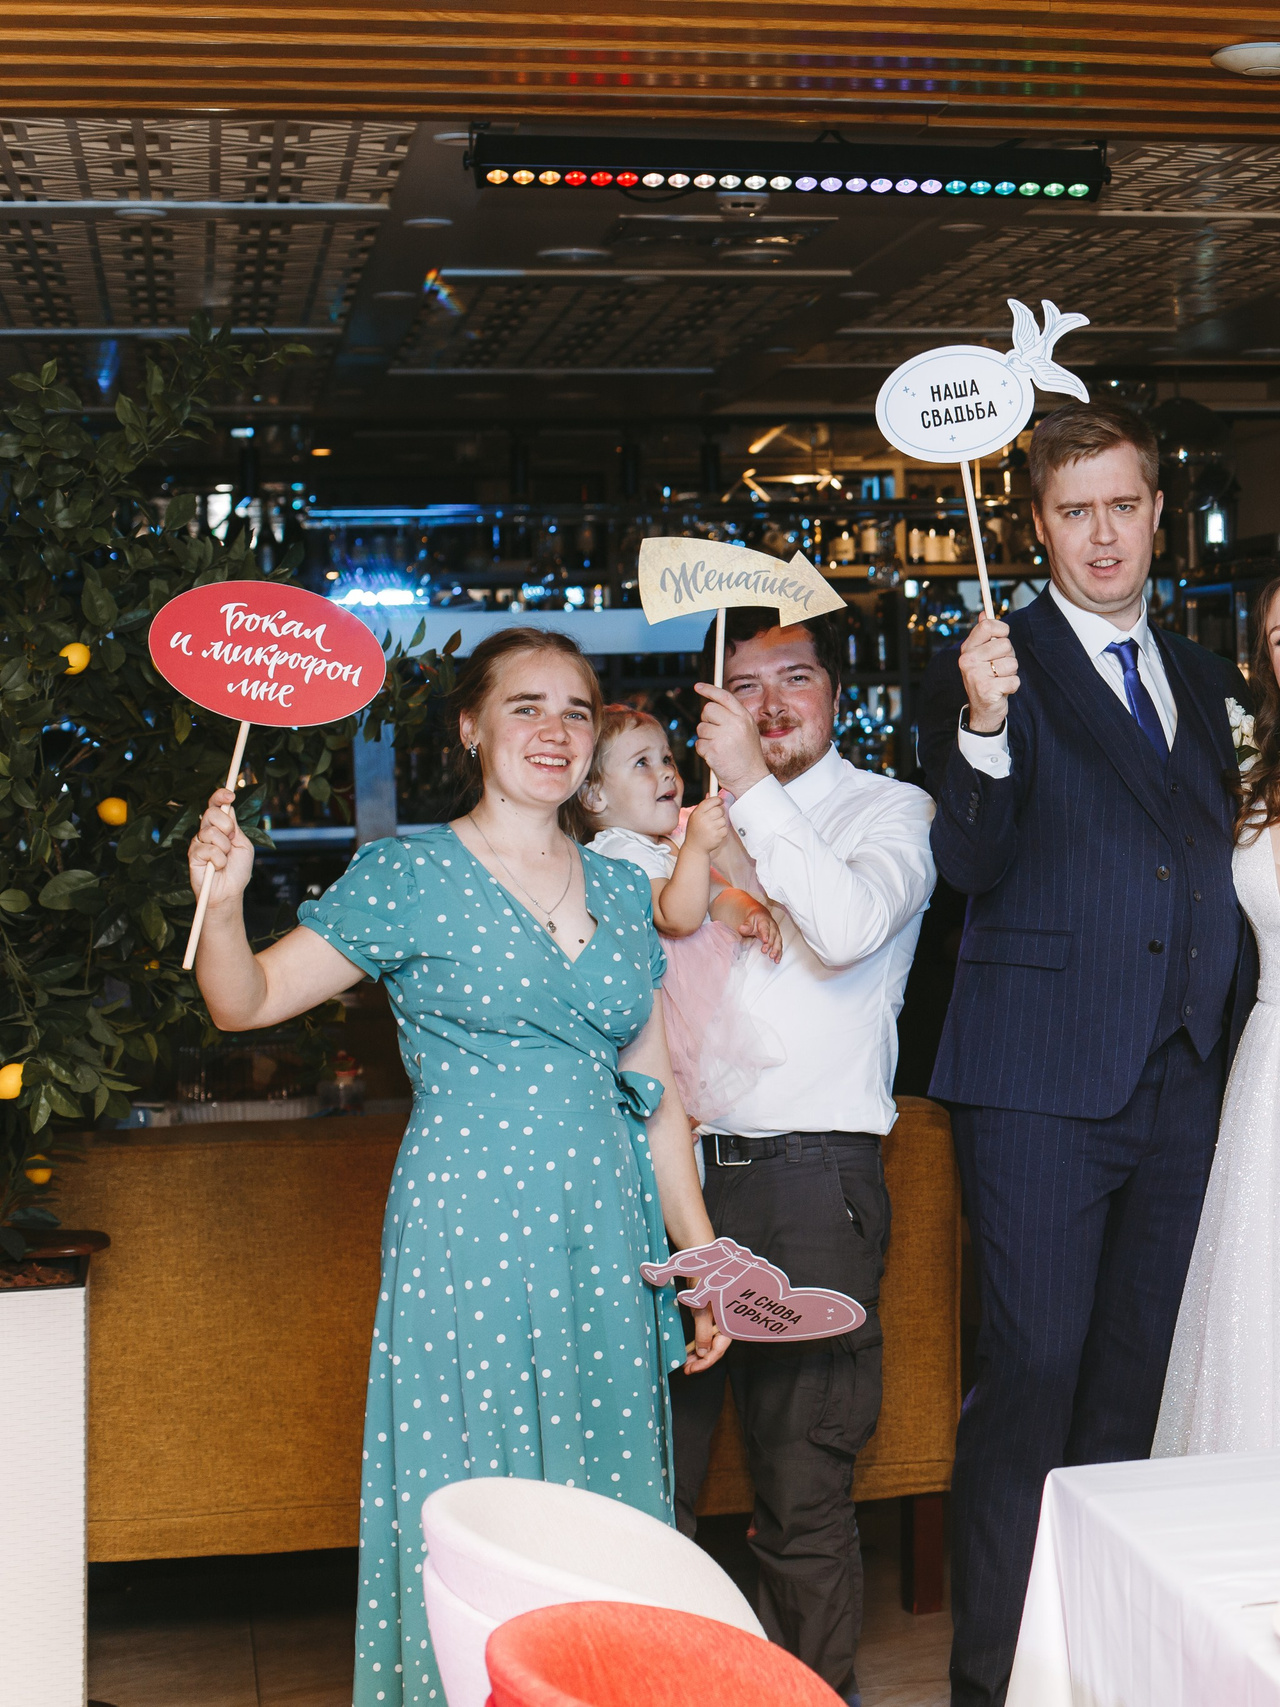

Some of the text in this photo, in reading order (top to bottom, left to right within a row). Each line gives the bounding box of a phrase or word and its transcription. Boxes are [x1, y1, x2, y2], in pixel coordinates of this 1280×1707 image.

[930, 379, 980, 402] НАША
[920, 400, 998, 429] СВАДЬБА
[659, 560, 815, 612] Женатики
[219, 602, 332, 652] Бокал
[201, 640, 363, 687] микрофон
[226, 678, 295, 708] мне
[725, 1300, 789, 1335] ГОРЬКО!
[739, 1288, 803, 1325] И СНОВА
